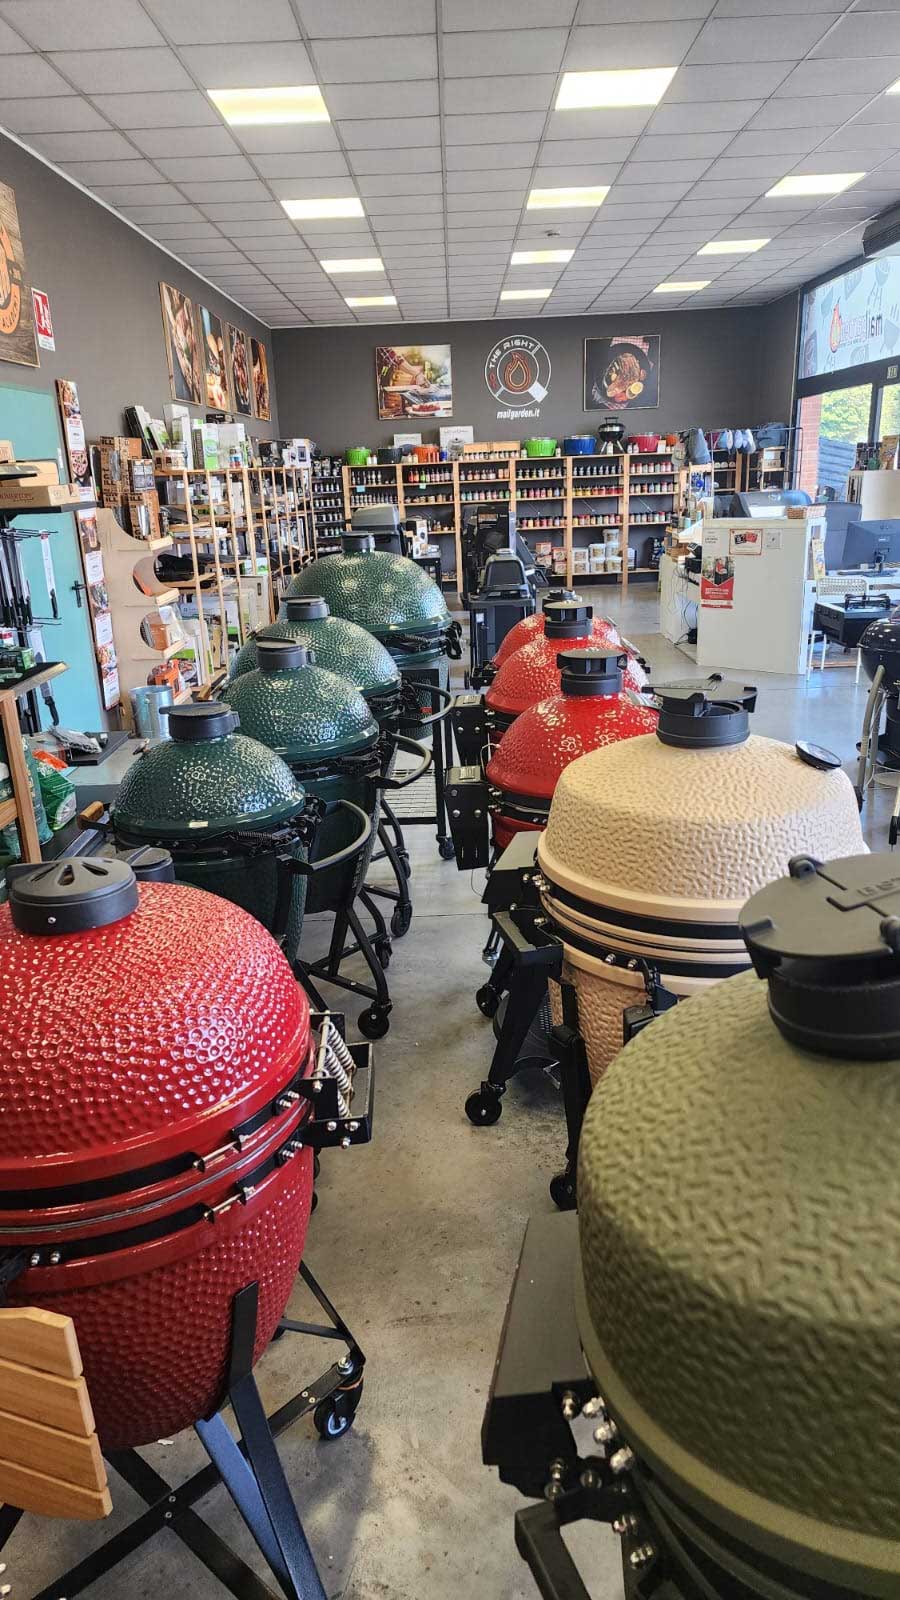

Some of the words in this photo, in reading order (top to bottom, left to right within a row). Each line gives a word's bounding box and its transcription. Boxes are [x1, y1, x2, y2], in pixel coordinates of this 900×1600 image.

[489, 348, 502, 369] THE
[503, 339, 535, 350] RIGHT
[496, 407, 540, 420] mailgarden.it
